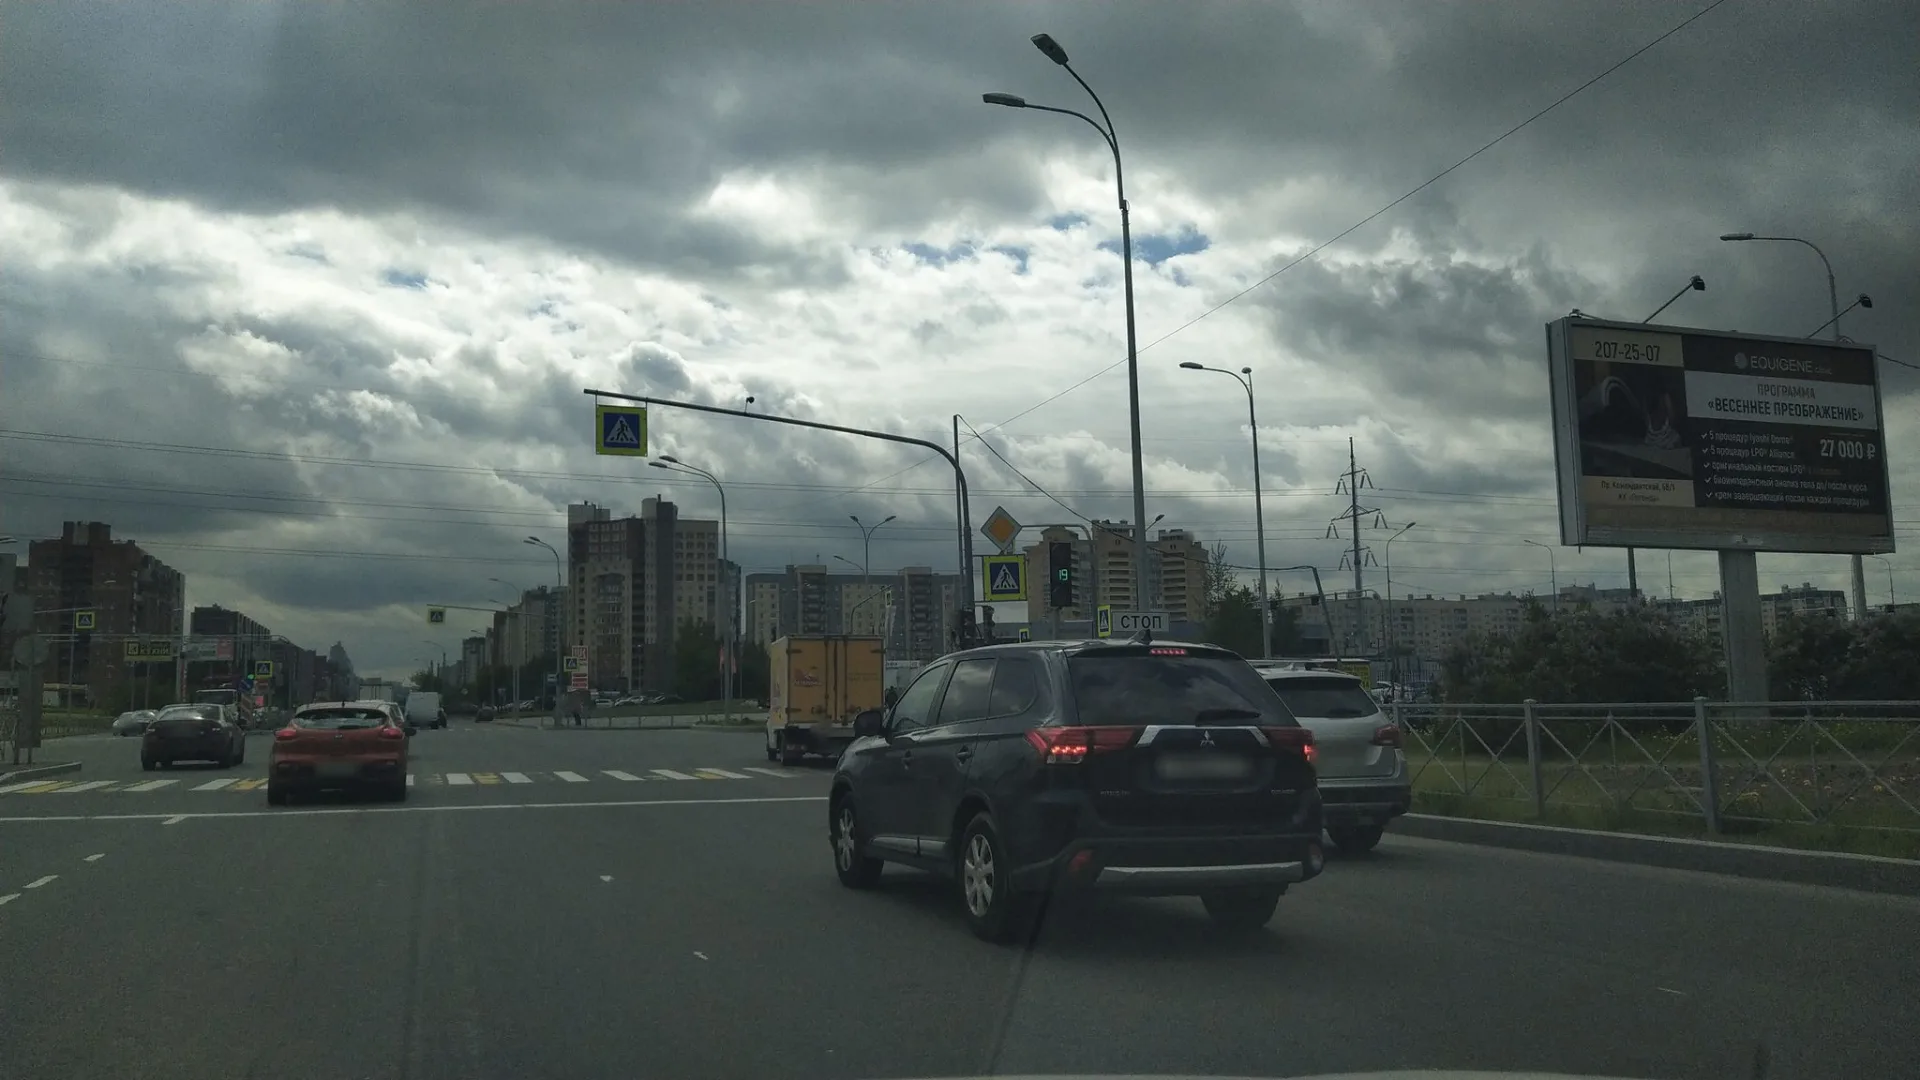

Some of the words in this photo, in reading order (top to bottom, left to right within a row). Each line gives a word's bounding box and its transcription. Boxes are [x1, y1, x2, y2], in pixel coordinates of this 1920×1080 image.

[1595, 341, 1660, 362] 207-25-07
[1751, 355, 1812, 374] EQUIGENE
[1757, 384, 1816, 399] ПРОГРАММА
[1708, 398, 1771, 416] «ВЕСЕННЕЕ
[1773, 402, 1864, 421] ПРЕОБРАЖЕНИЕ»
[1820, 439, 1834, 458] 27
[1838, 441, 1864, 459] 000
[1059, 568, 1068, 581] 19
[1121, 616, 1162, 629] СТОП
